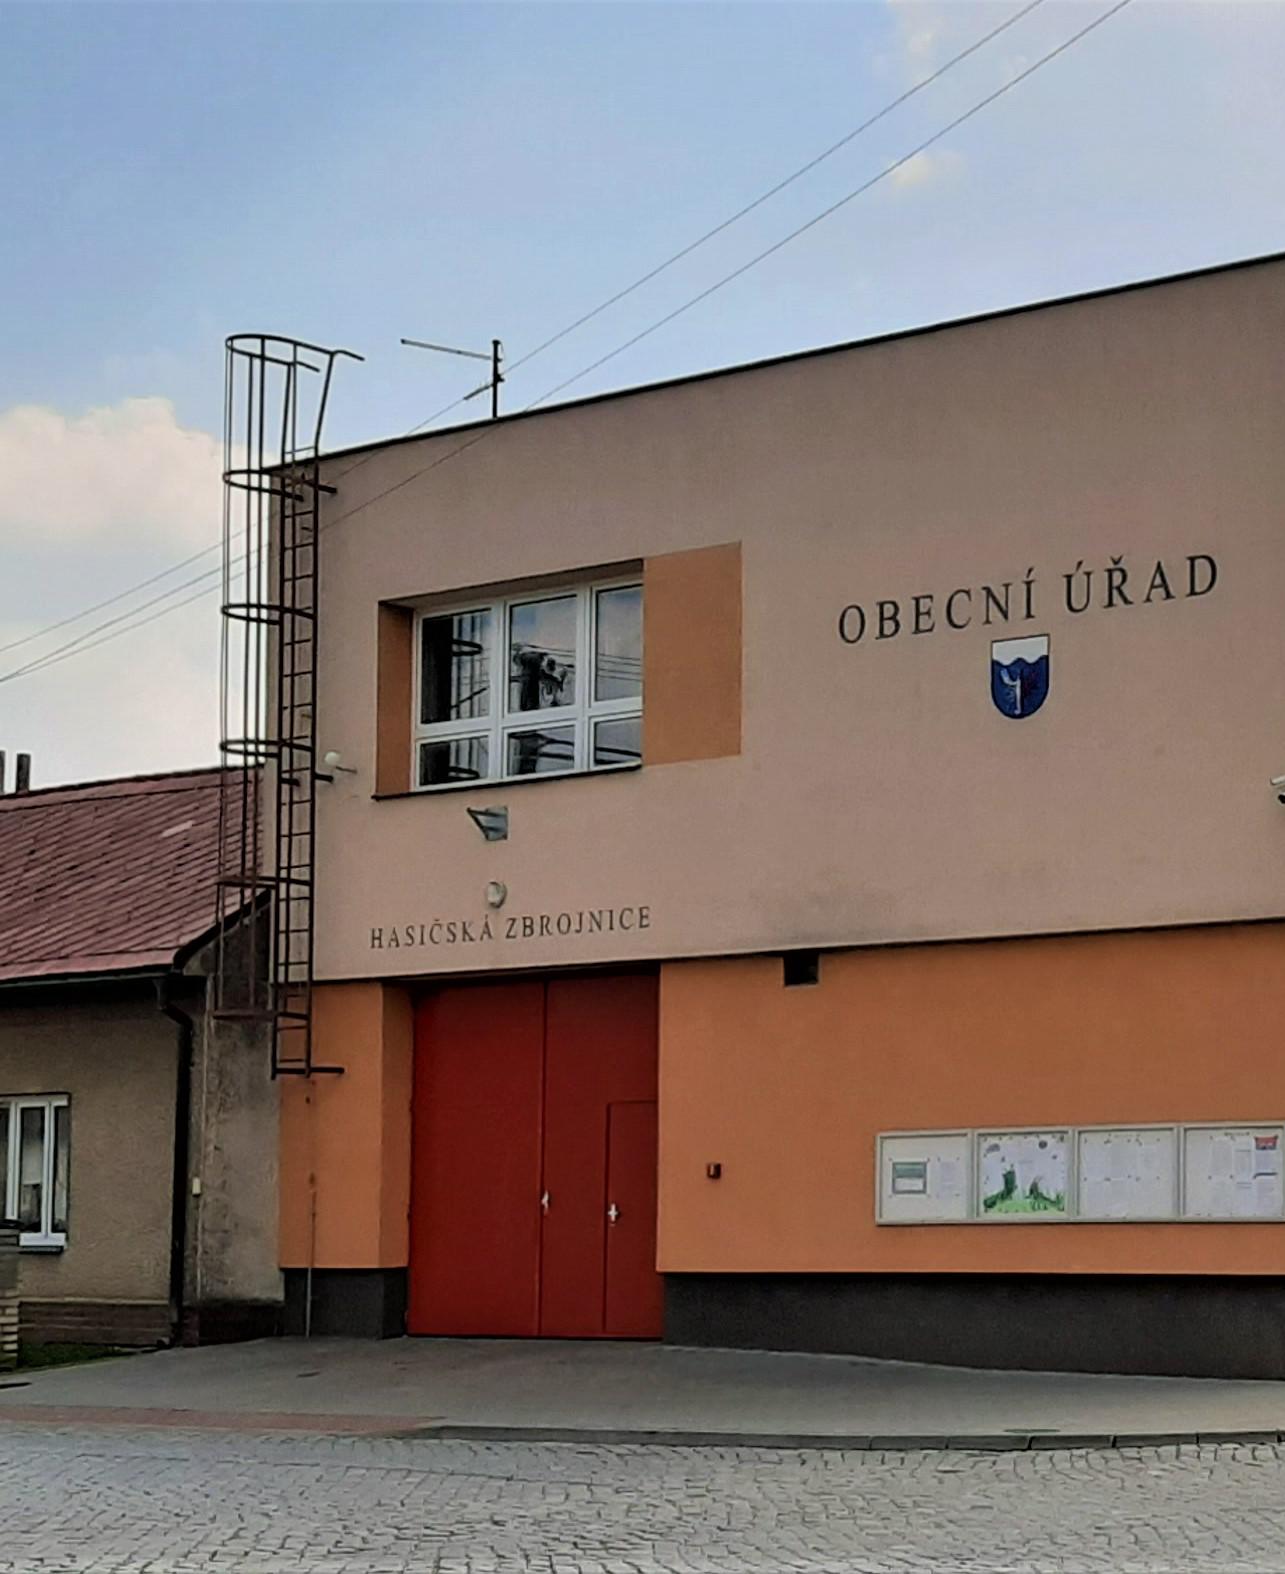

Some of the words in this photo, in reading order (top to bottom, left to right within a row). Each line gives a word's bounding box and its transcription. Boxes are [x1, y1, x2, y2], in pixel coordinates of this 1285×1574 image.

[838, 567, 1037, 645] OBECNÍ
[1062, 554, 1218, 614] ÚŘAD
[370, 914, 494, 949] HASIČSKÁ
[505, 906, 651, 940] ZBROJNICE
